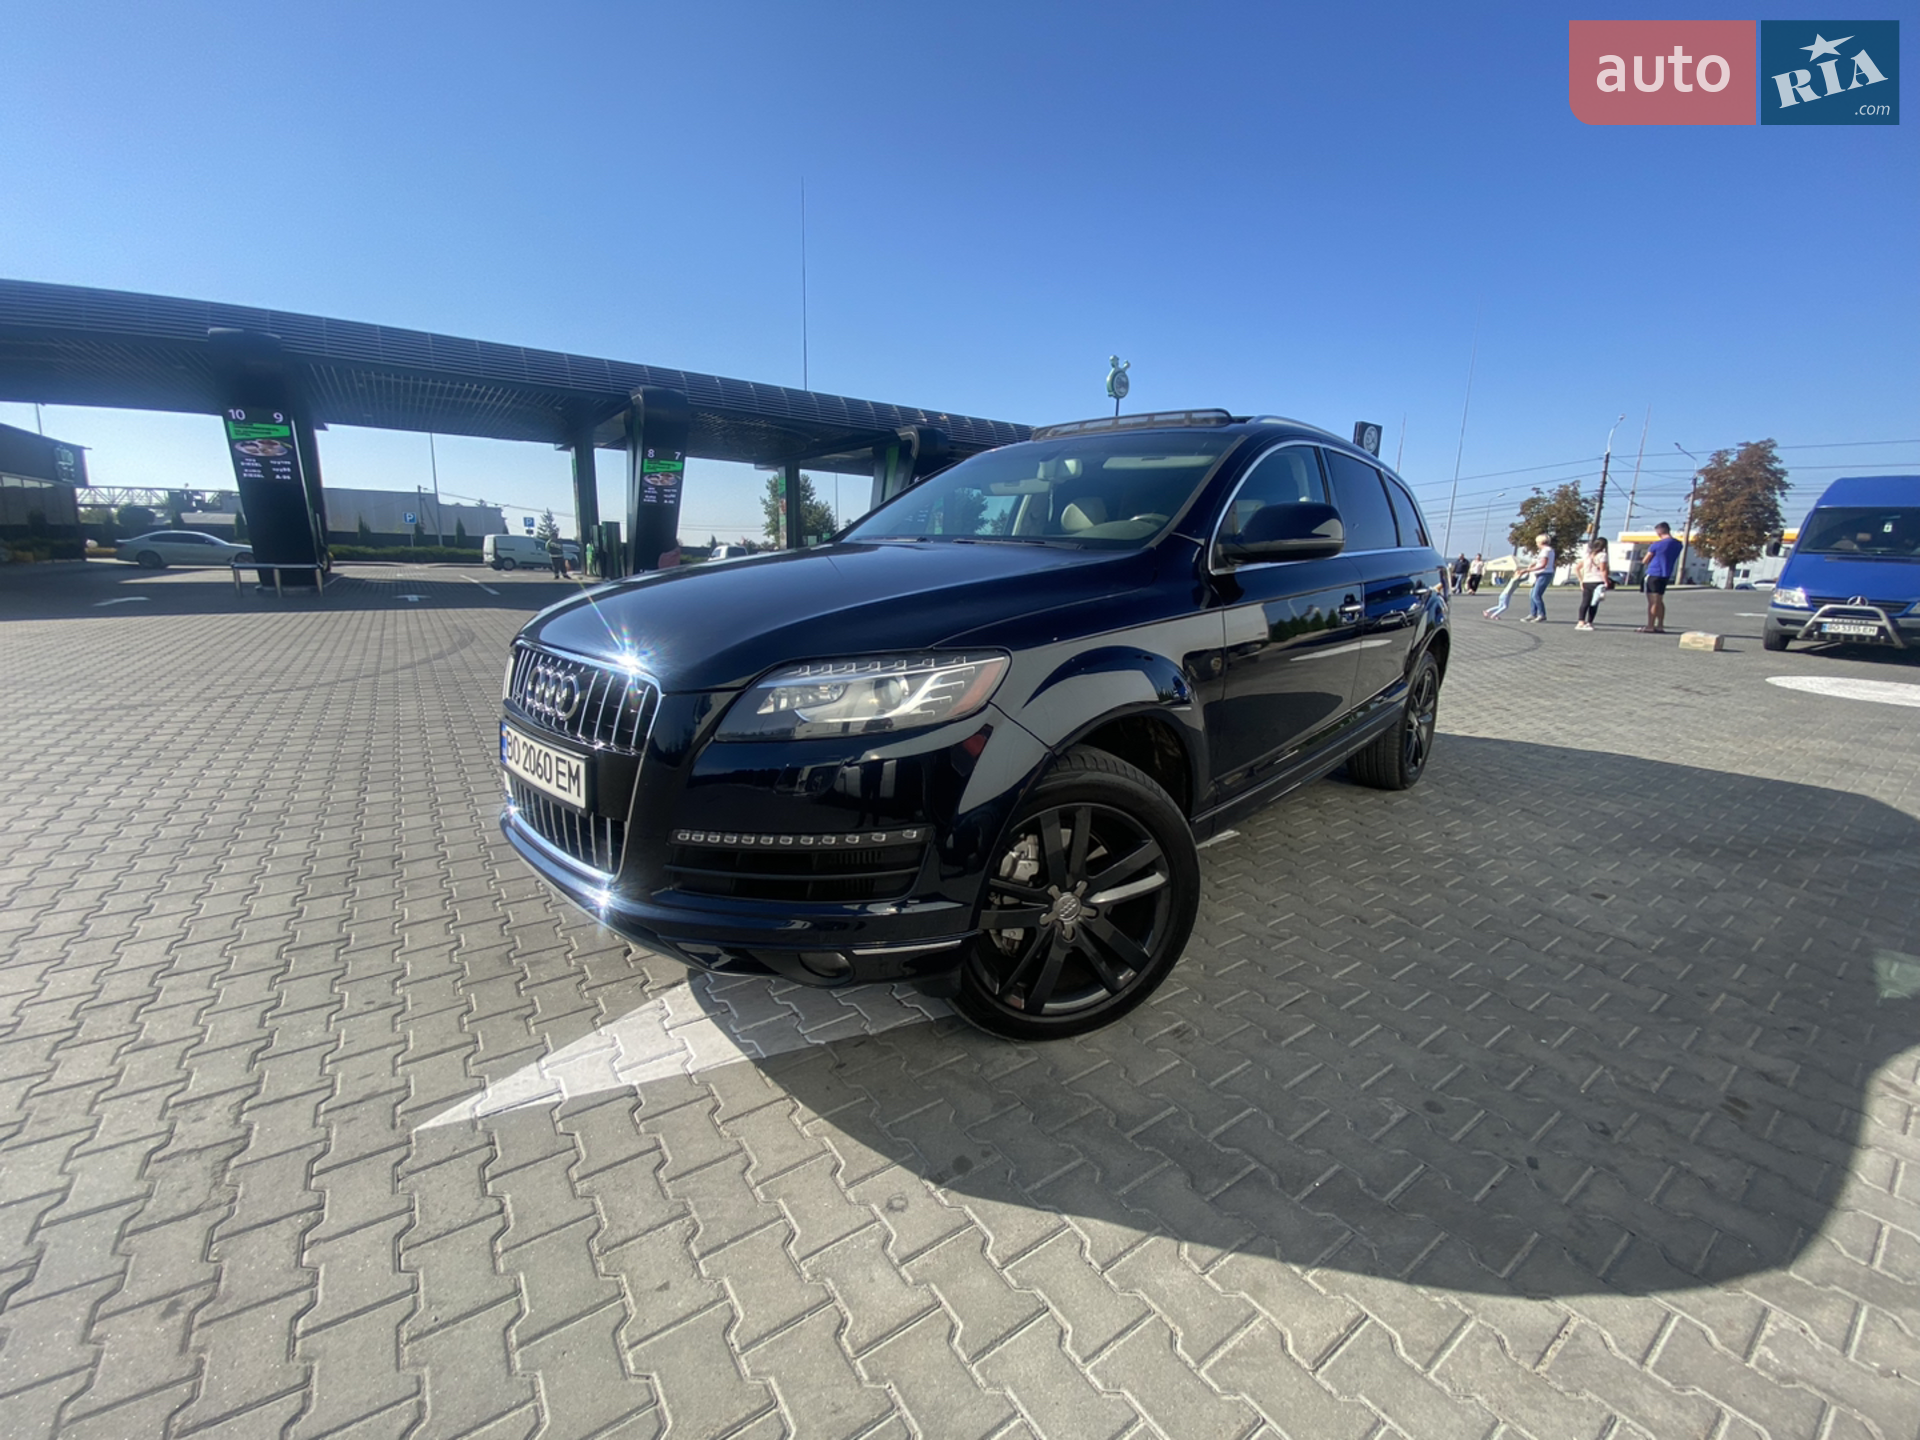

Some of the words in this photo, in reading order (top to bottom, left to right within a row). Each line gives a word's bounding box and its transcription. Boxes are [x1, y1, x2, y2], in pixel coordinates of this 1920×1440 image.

[228, 408, 246, 421] 10
[273, 412, 284, 424] 9
[647, 448, 655, 459] 8
[674, 451, 682, 461] 7
[406, 512, 414, 523] P
[526, 518, 533, 527] P
[506, 730, 520, 765] BO
[522, 741, 553, 785] 2060
[555, 755, 581, 798] EM
